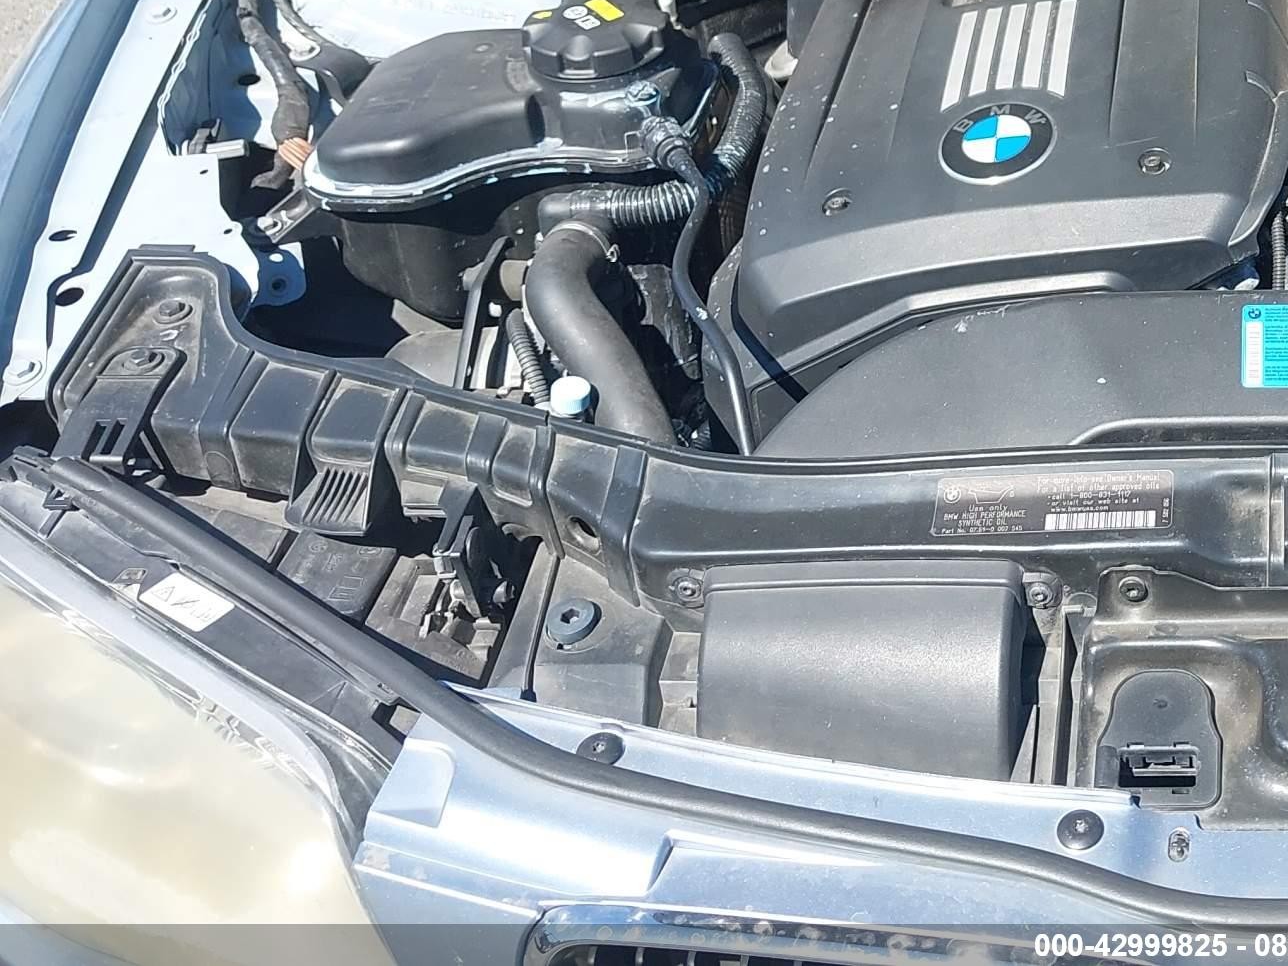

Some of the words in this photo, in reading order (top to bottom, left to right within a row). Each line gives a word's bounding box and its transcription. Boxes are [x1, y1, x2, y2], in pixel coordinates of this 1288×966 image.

[953, 104, 1047, 133] BMW
[1137, 473, 1160, 482] Manual
[1090, 483, 1108, 491] other
[1112, 483, 1142, 492] approved
[1146, 482, 1160, 490] oils
[944, 513, 959, 521] BMW
[962, 511, 977, 520] HIGH
[981, 510, 1027, 519] PERFORMANCE
[958, 519, 993, 527] SYNTHETIC
